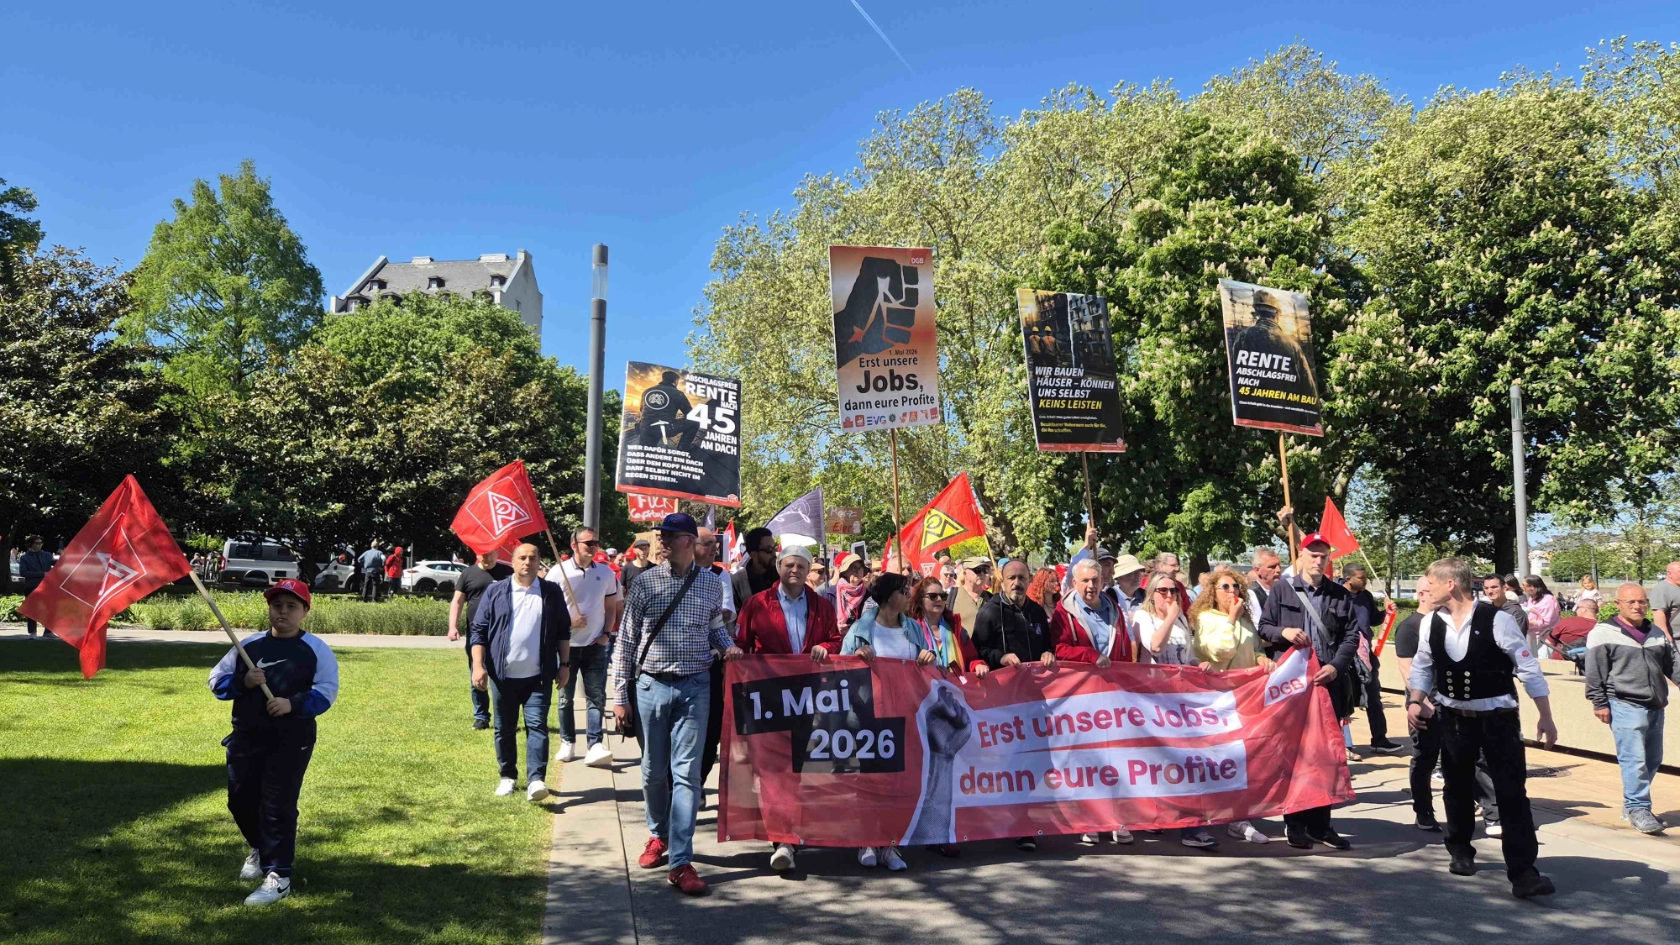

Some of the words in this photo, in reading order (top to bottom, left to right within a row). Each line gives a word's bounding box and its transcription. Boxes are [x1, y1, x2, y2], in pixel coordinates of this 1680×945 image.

[859, 358, 880, 368] Erst
[883, 356, 918, 367] unsere
[1236, 349, 1292, 372] RENTE
[1035, 366, 1053, 376] WIR
[1054, 367, 1084, 377] BAUEN
[1236, 367, 1297, 382] ABSCHLAGSFREI
[685, 374, 738, 390] ABSCHLAGSFREIE
[856, 369, 924, 394] Jobs,
[1036, 375, 1073, 388] HÄUSER
[1080, 377, 1115, 390] KÖNNEN
[1238, 377, 1260, 386] NACH
[686, 381, 738, 404] RENTE
[1037, 388, 1057, 398] UNS
[1058, 388, 1091, 398] SELBST
[1238, 386, 1250, 396] 45
[1251, 388, 1287, 400] JAHREN
[1287, 392, 1300, 402] AM
[1300, 395, 1317, 405] BAU
[721, 401, 738, 410] NACH
[844, 400, 872, 411] dann
[874, 398, 898, 408] eure
[901, 394, 935, 406] Profite
[1038, 399, 1066, 408] KEINS
[1067, 400, 1103, 410] LEISTEN
[686, 403, 736, 434] 45
[704, 432, 738, 445] JAHREN
[644, 446, 667, 454] DAFÜR
[668, 448, 691, 458] SORGT,
[700, 440, 714, 451] AM
[715, 442, 738, 456] DACH
[645, 453, 672, 462] ANDERE
[673, 456, 685, 464] EIN
[686, 458, 704, 467] DACH
[644, 466, 670, 475] SELBST
[670, 470, 692, 478] NICHT
[662, 461, 680, 470] KOPF
[680, 464, 706, 476] HABEN,
[649, 474, 679, 484] STEHEN.
[1268, 678, 1304, 700] DGB
[750, 691, 772, 720] 1.
[781, 679, 850, 717] Mai
[977, 716, 1026, 748] Erst
[1032, 706, 1145, 737] unsere
[1151, 702, 1229, 730] Jobs,
[809, 729, 896, 759] 2026
[959, 766, 1036, 795] dann
[1044, 763, 1120, 790] eure
[1127, 756, 1238, 786] Profite
